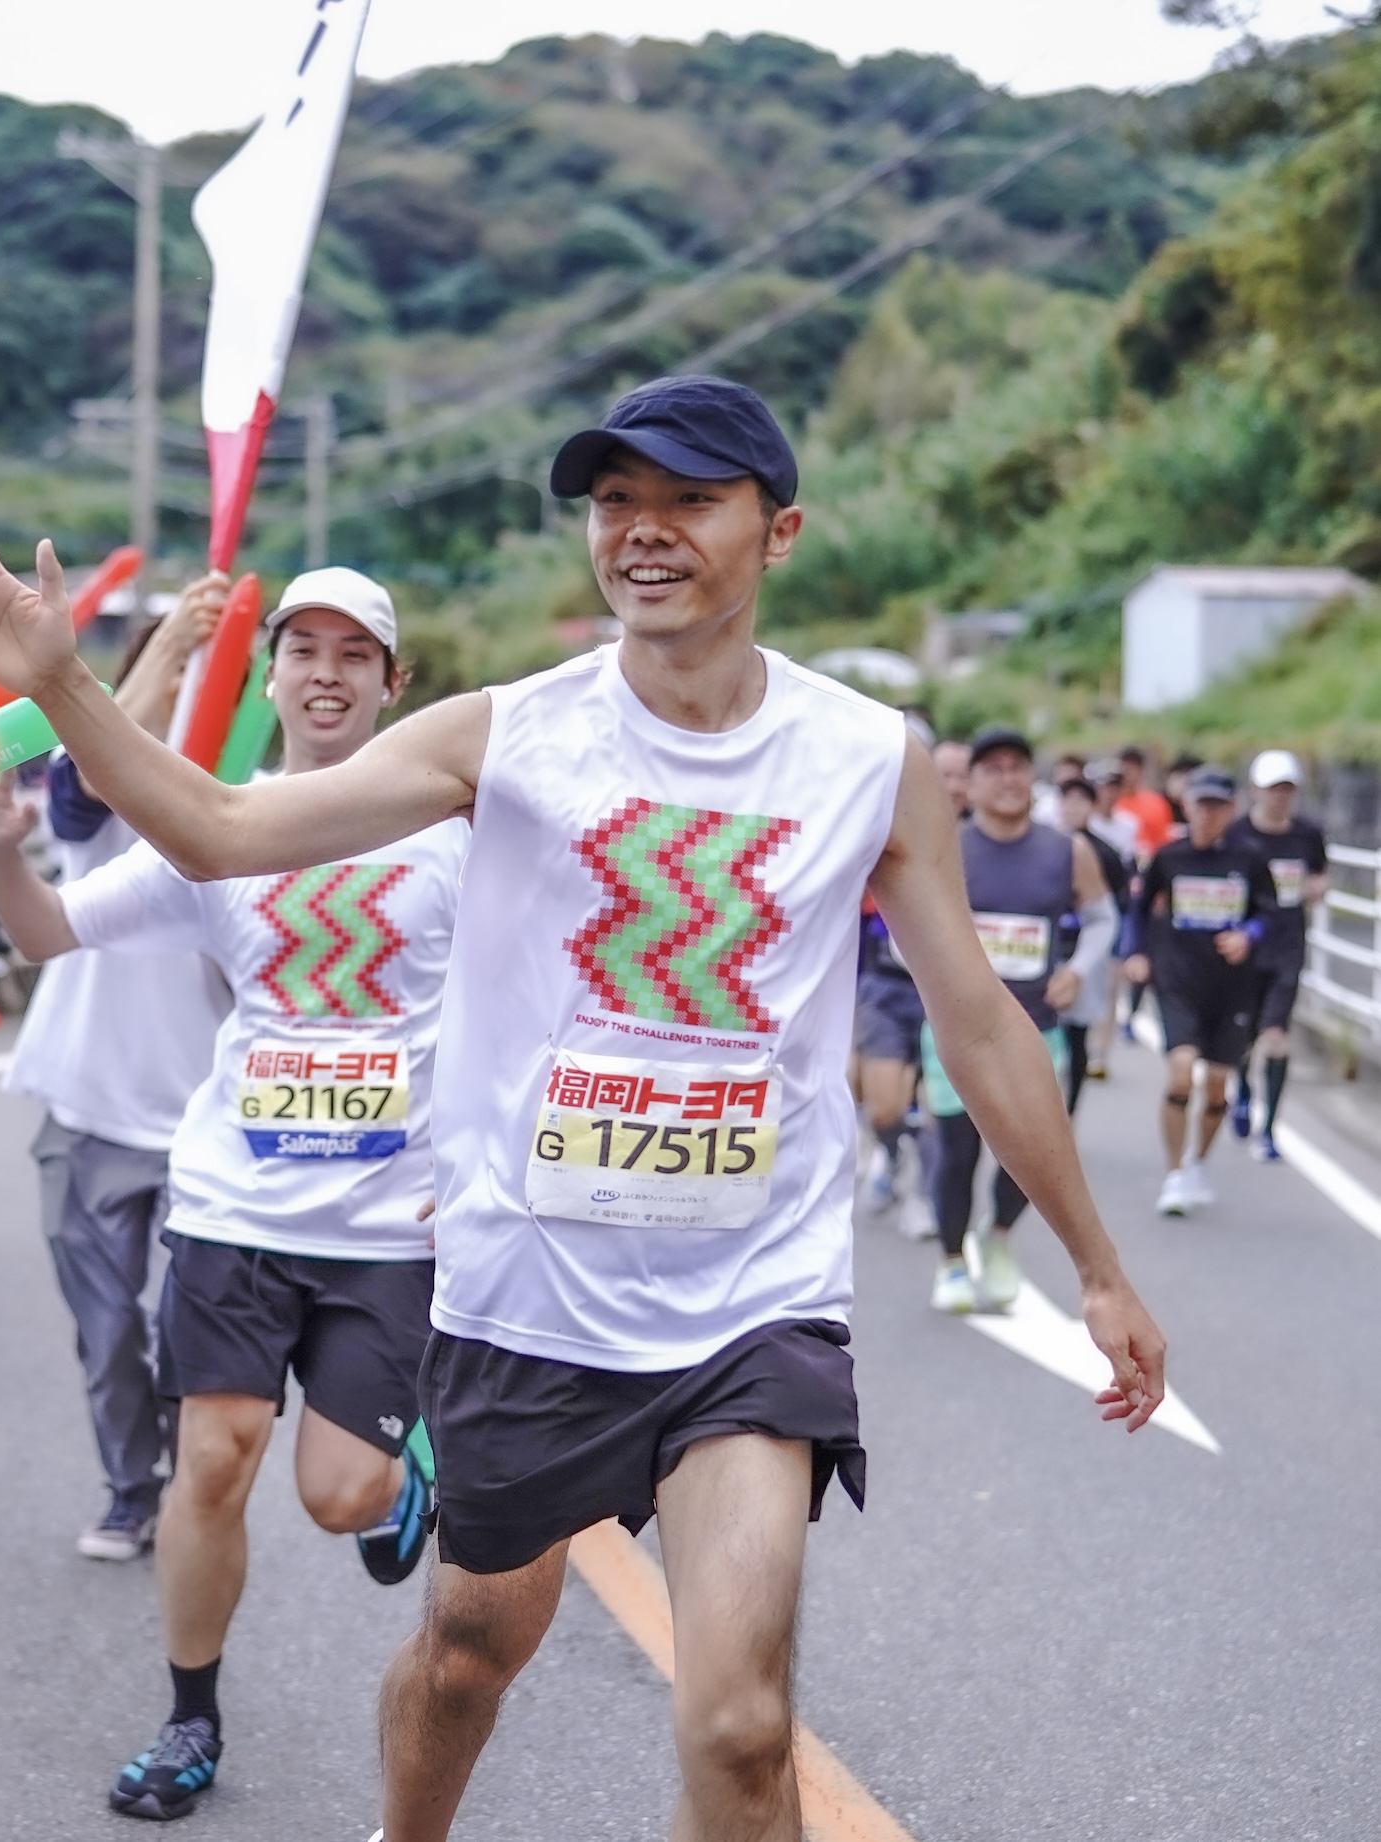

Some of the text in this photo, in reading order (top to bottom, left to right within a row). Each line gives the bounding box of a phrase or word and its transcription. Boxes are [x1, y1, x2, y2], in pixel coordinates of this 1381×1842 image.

[575, 1014, 760, 1051] ENJOY THE CHALLENGES TOGETHER!
[246, 1050, 398, 1080] 福岡トヨタ
[242, 1084, 393, 1120] G 21167
[546, 1065, 769, 1120] 福岡トヨタ
[276, 1133, 359, 1157] Salonpas
[536, 1119, 756, 1175] G 17515
[596, 1188, 616, 1198] FFG
